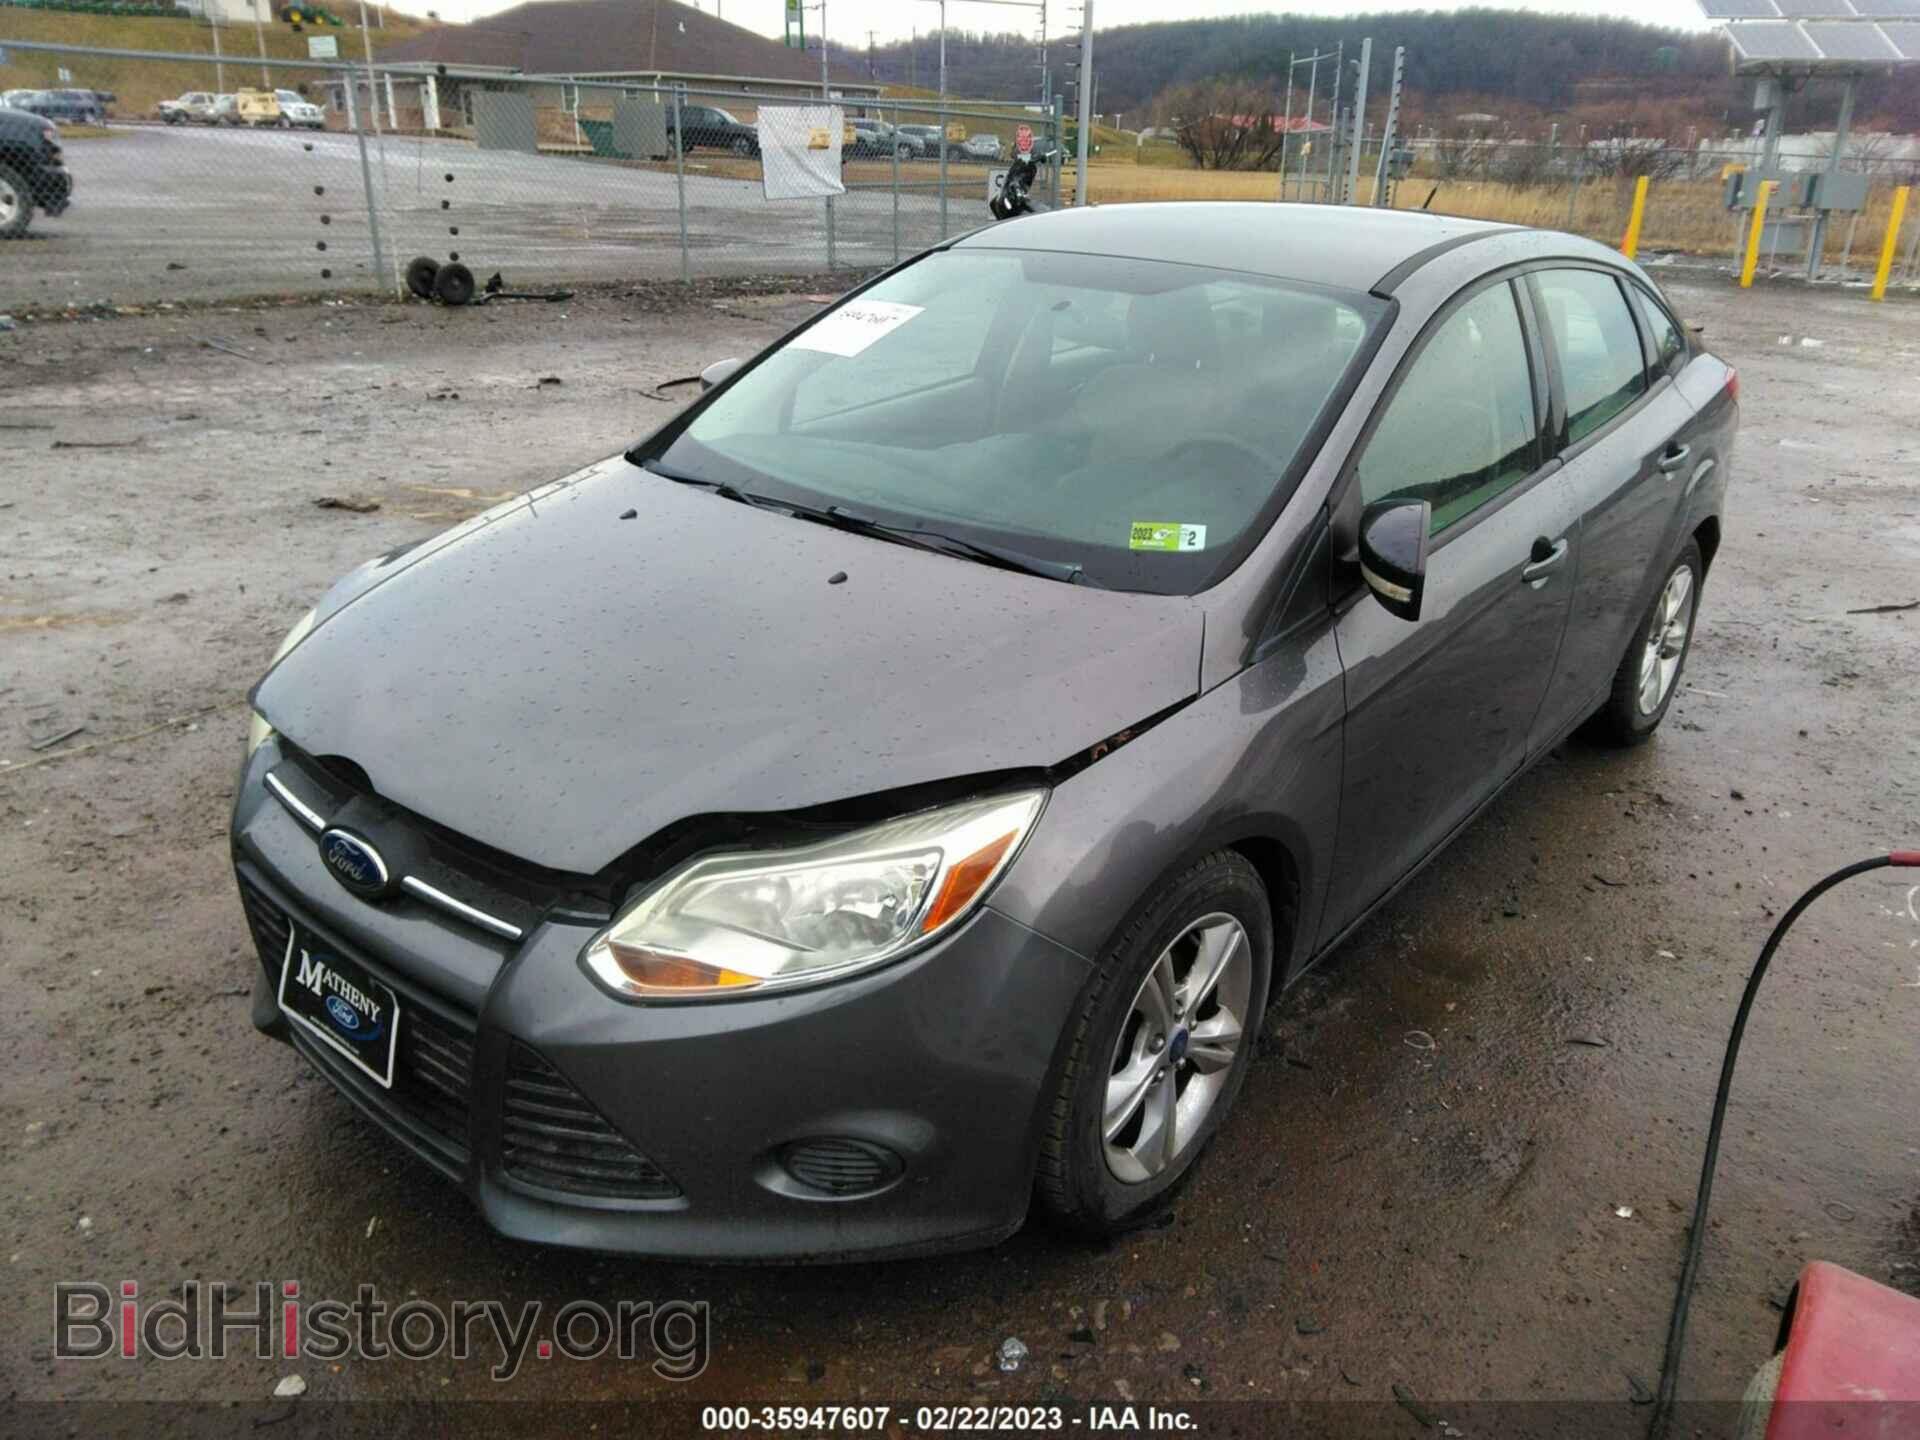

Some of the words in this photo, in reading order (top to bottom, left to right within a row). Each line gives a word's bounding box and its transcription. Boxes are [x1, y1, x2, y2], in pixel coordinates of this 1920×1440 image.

[1132, 527, 1153, 540] 2023
[1187, 531, 1196, 546] 2
[328, 839, 368, 881] Ford
[296, 949, 381, 1023] MATHENY
[332, 1000, 353, 1025] Ford
